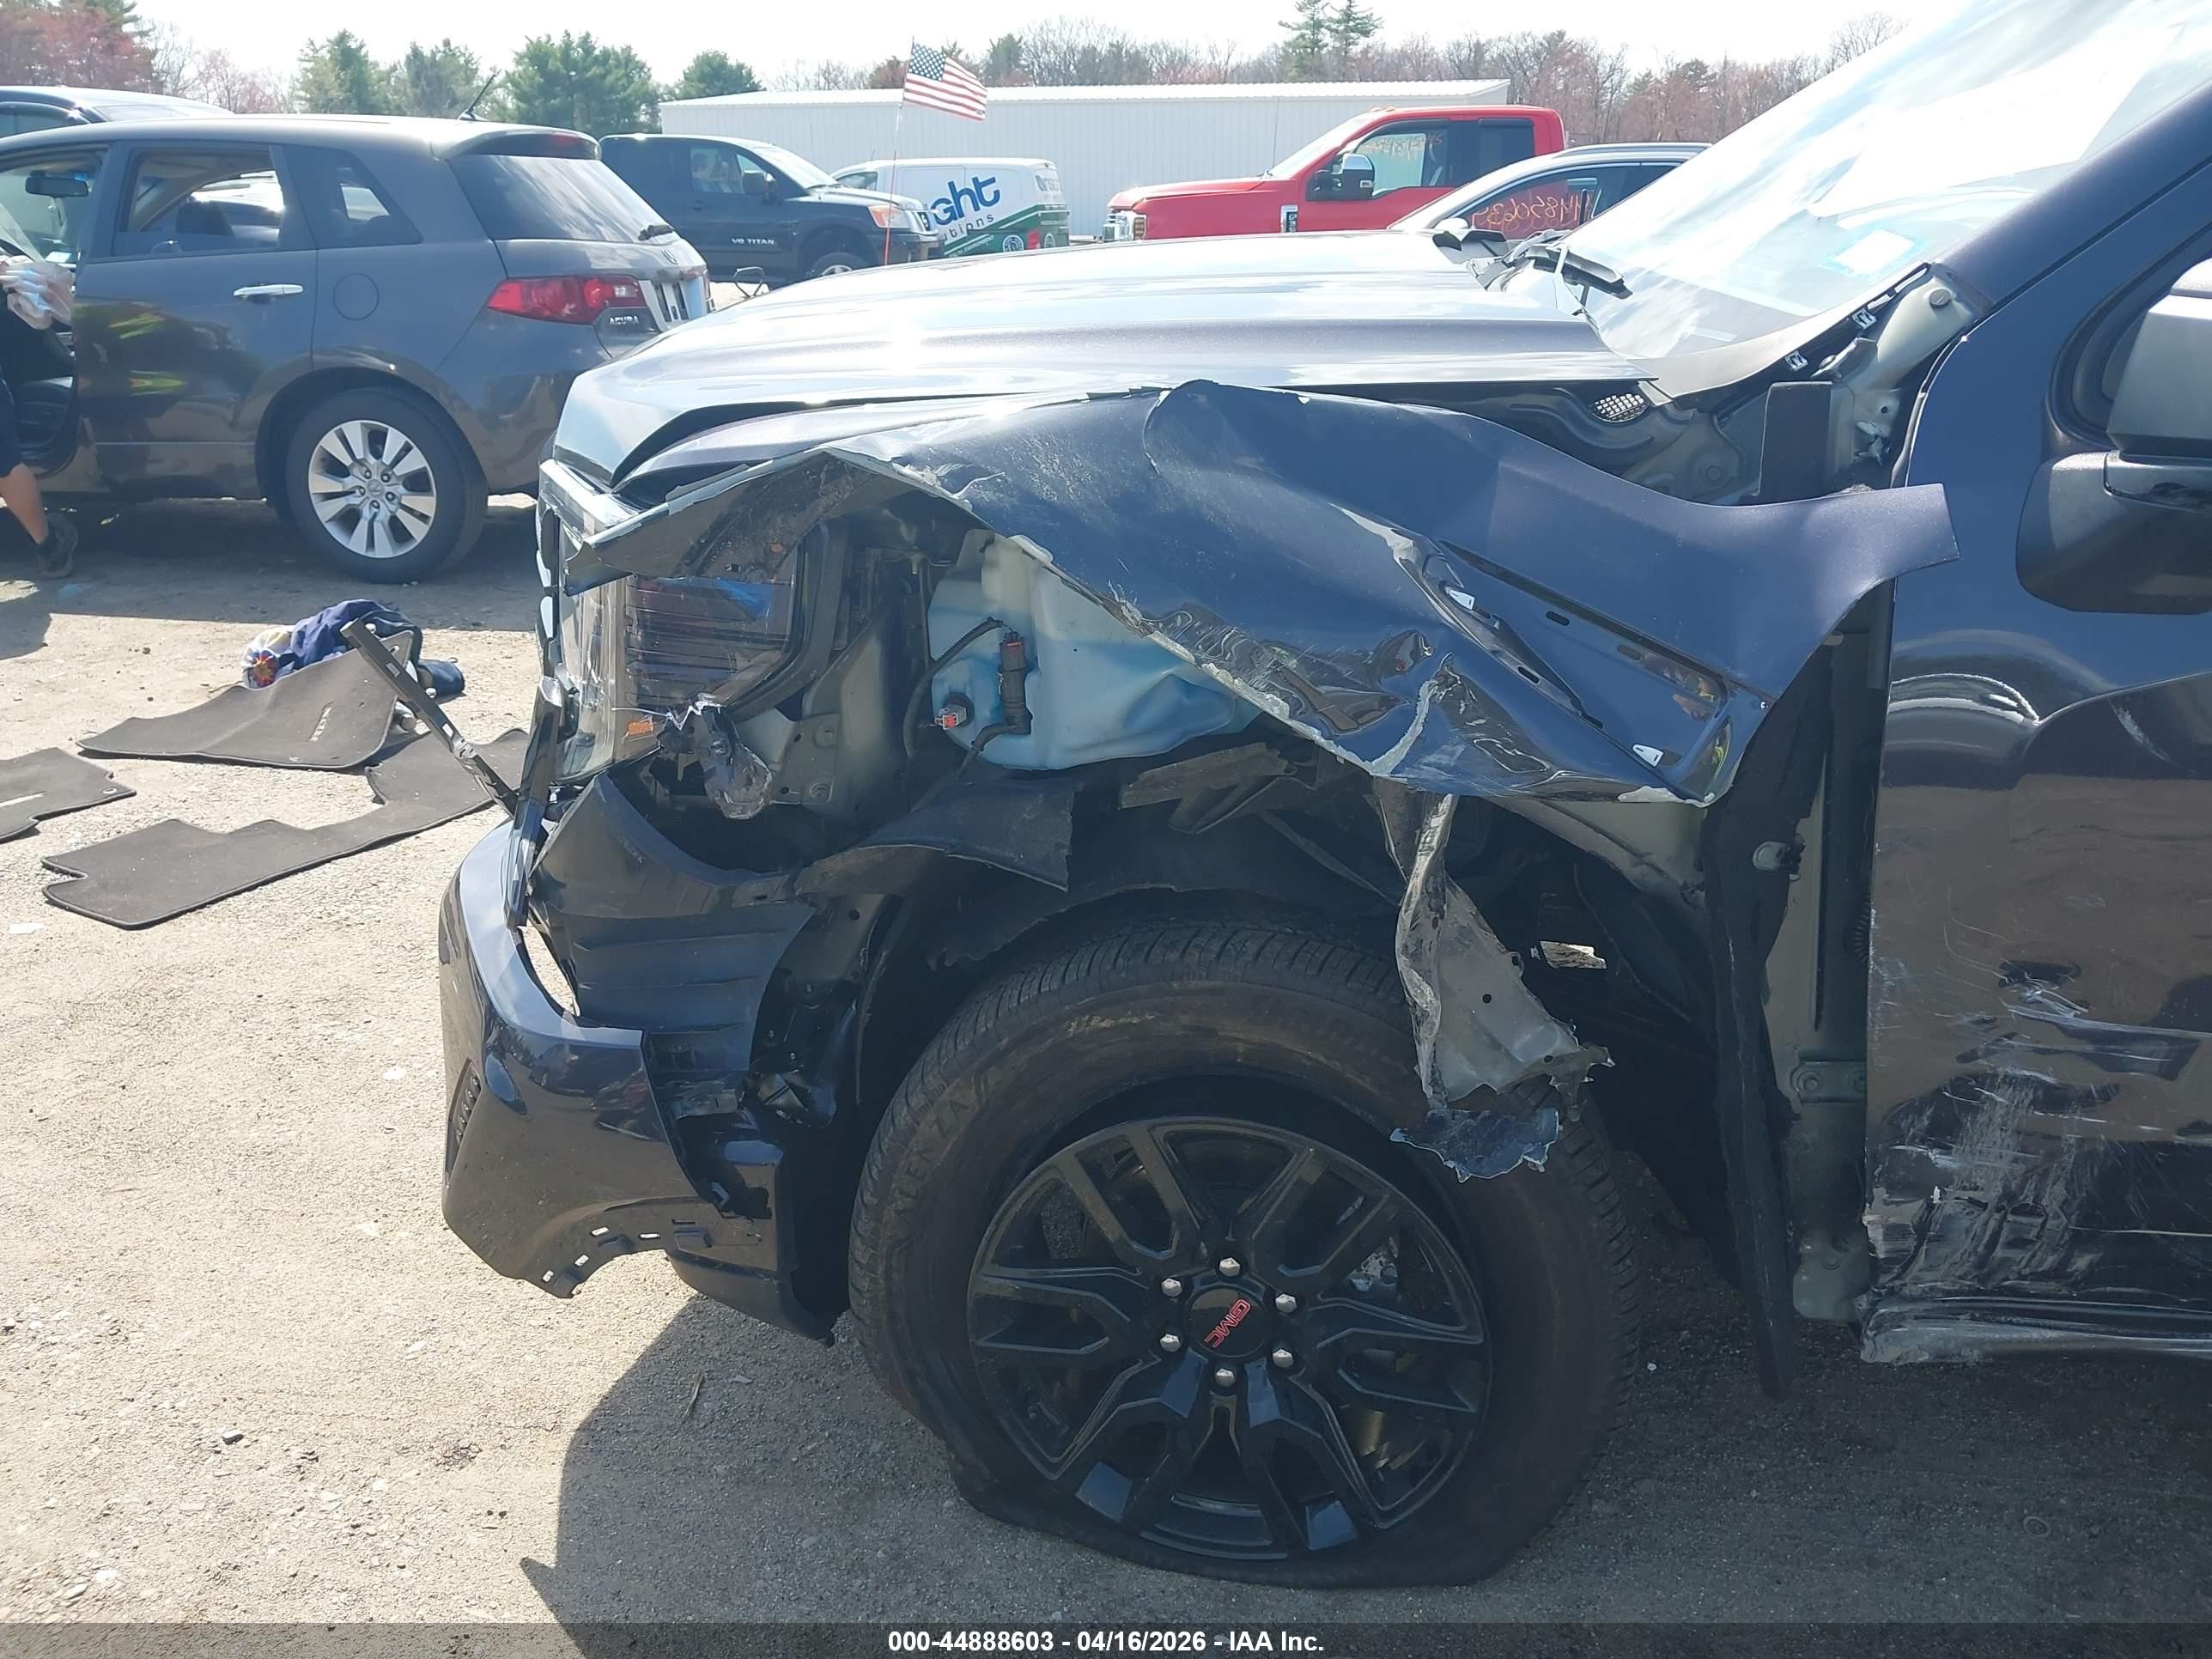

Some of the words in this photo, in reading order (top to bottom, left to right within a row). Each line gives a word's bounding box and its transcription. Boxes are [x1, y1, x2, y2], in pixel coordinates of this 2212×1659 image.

[931, 176, 1000, 226] ght
[609, 315, 639, 325] ACURA
[1204, 1298, 1251, 1348] GMC
